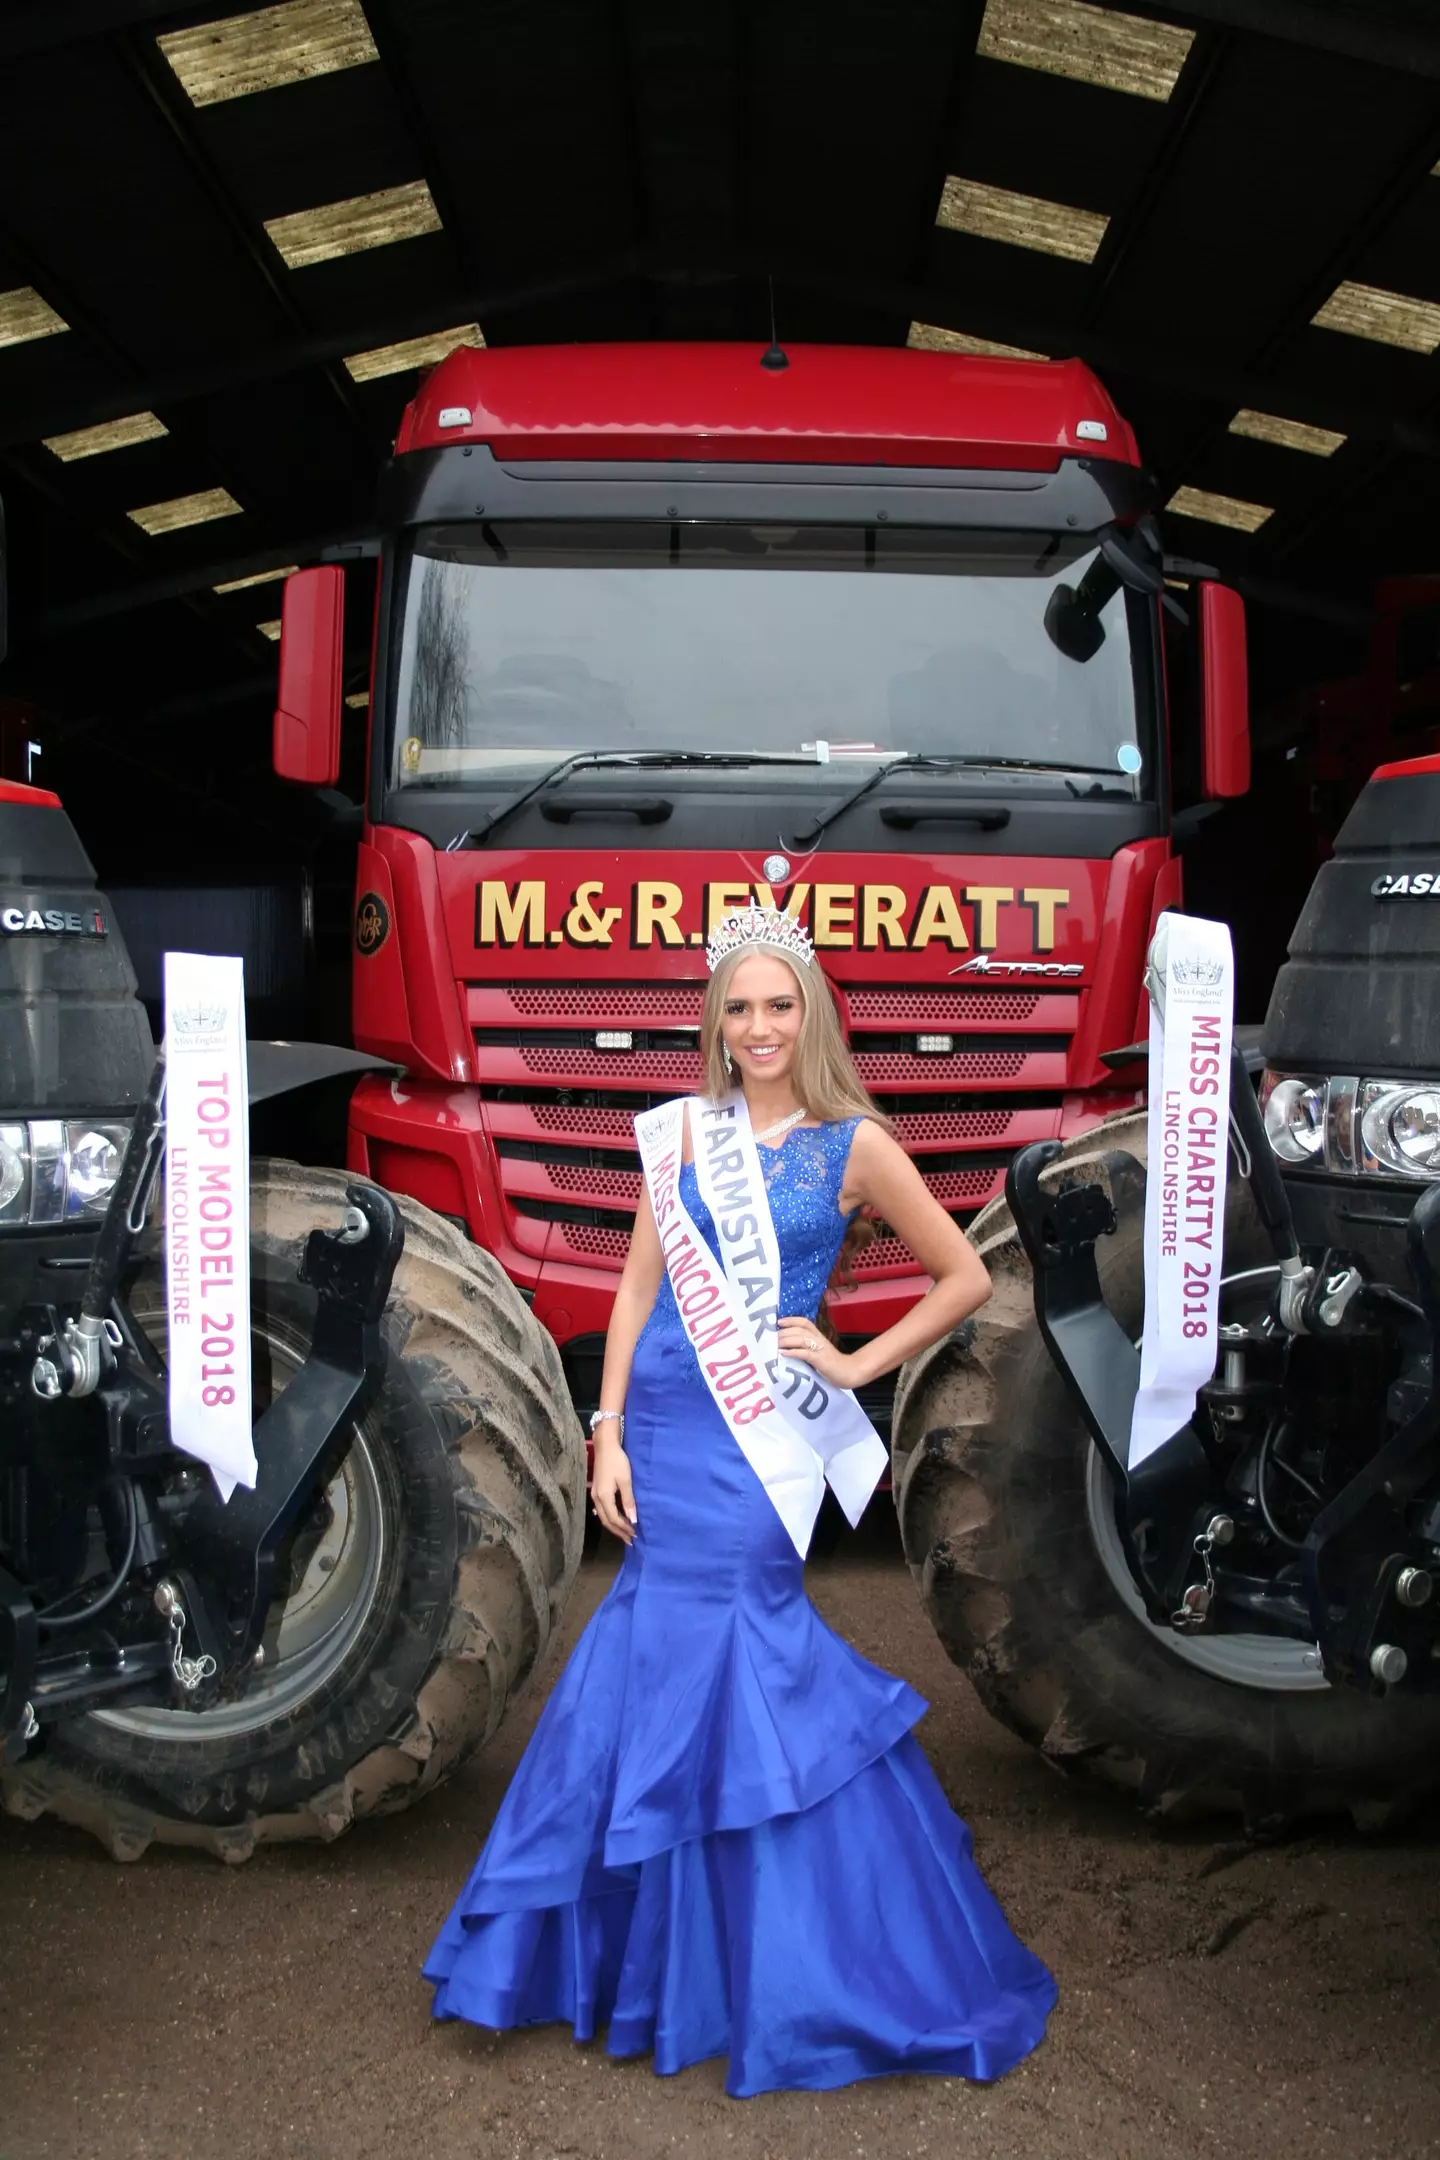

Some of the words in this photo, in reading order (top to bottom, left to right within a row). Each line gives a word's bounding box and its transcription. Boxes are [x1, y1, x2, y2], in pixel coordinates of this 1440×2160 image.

[3, 908, 82, 931] CASE
[947, 954, 1085, 977] ACTROS
[1189, 1015, 1221, 1096] MISS
[197, 1072, 231, 1149] TOP
[650, 1149, 676, 1229] MISS
[1161, 1090, 1181, 1257] LINCOLNSHIRE
[1184, 1107, 1218, 1251] CHARITY
[171, 1147, 191, 1325] LINCOLNSHIRE
[198, 1165, 234, 1299] MODEL
[701, 1104, 779, 1343] FARMSTAR
[661, 1219, 740, 1354] LINCOLN
[1182, 1261, 1212, 1339] 2018
[200, 1313, 236, 1407] 2018
[705, 1344, 776, 1426] 2018
